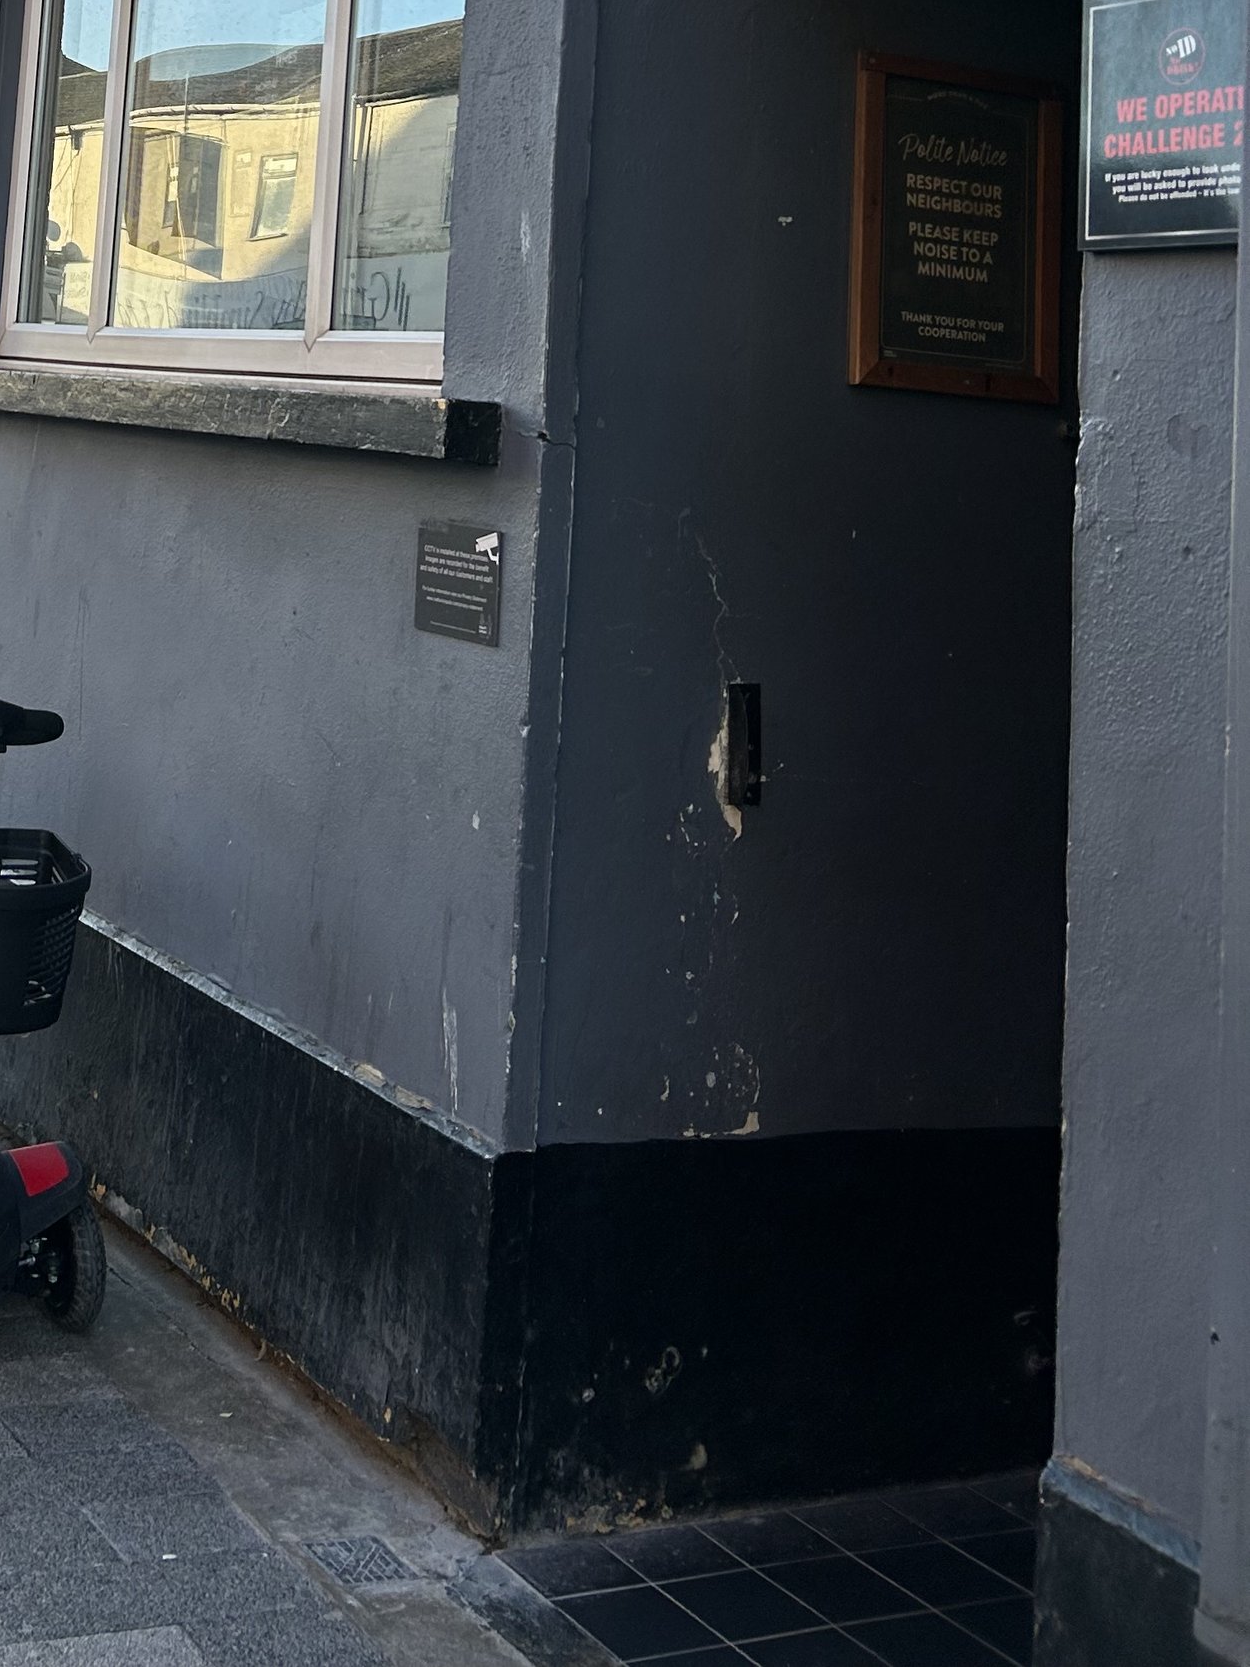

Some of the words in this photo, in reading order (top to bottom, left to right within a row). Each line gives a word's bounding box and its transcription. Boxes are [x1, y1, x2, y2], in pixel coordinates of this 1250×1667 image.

[1177, 34, 1196, 58] ID
[1117, 97, 1147, 123] WE
[899, 133, 954, 162] Polite
[957, 139, 1008, 167] Notice
[1104, 123, 1225, 158] CHALLENGE
[906, 173, 968, 195] RESPECT
[971, 183, 1003, 201] OUR
[906, 193, 1003, 219] NEIGHBOURS
[908, 221, 960, 242] PLEASE
[963, 229, 999, 247] KEEP
[913, 240, 958, 261] NOISE
[960, 248, 981, 263] TO
[982, 251, 994, 266] A
[917, 261, 989, 283] MINIMUM
[901, 310, 933, 326] THANK
[934, 314, 955, 328] YOU
[956, 317, 976, 330] FOR
[977, 319, 1004, 333] YOUR
[918, 326, 986, 344] COOPERATION
